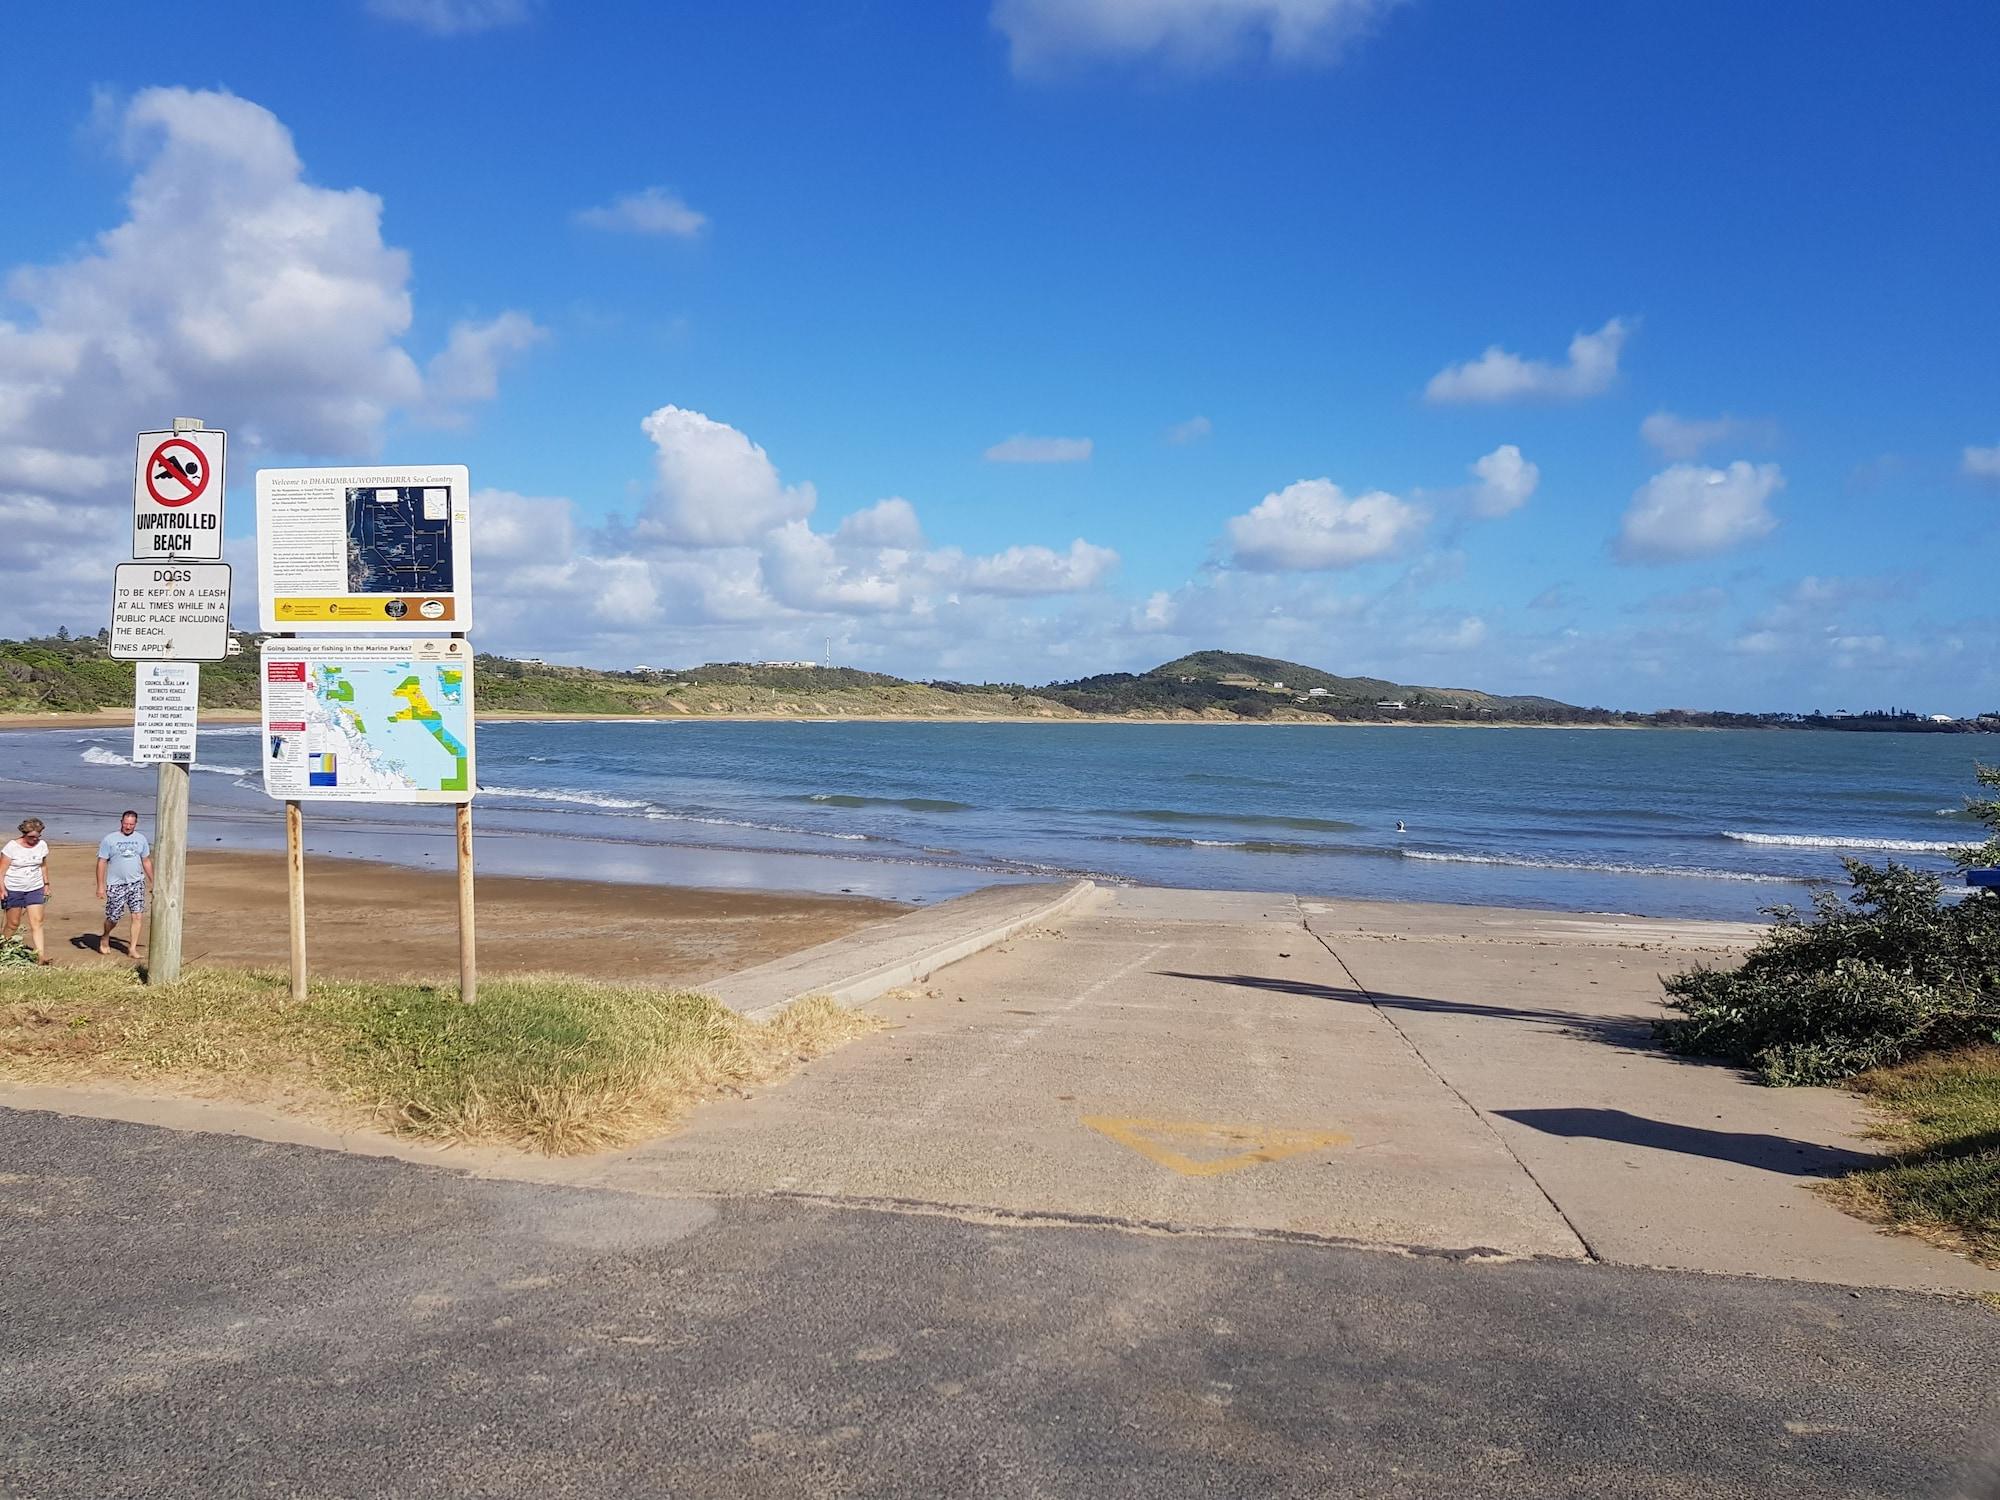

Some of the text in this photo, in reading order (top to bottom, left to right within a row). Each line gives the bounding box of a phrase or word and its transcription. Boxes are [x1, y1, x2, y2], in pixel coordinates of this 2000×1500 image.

[137, 513, 216, 530] UNPATROLLED
[154, 534, 192, 550] BEACH
[154, 570, 192, 582] DOGS
